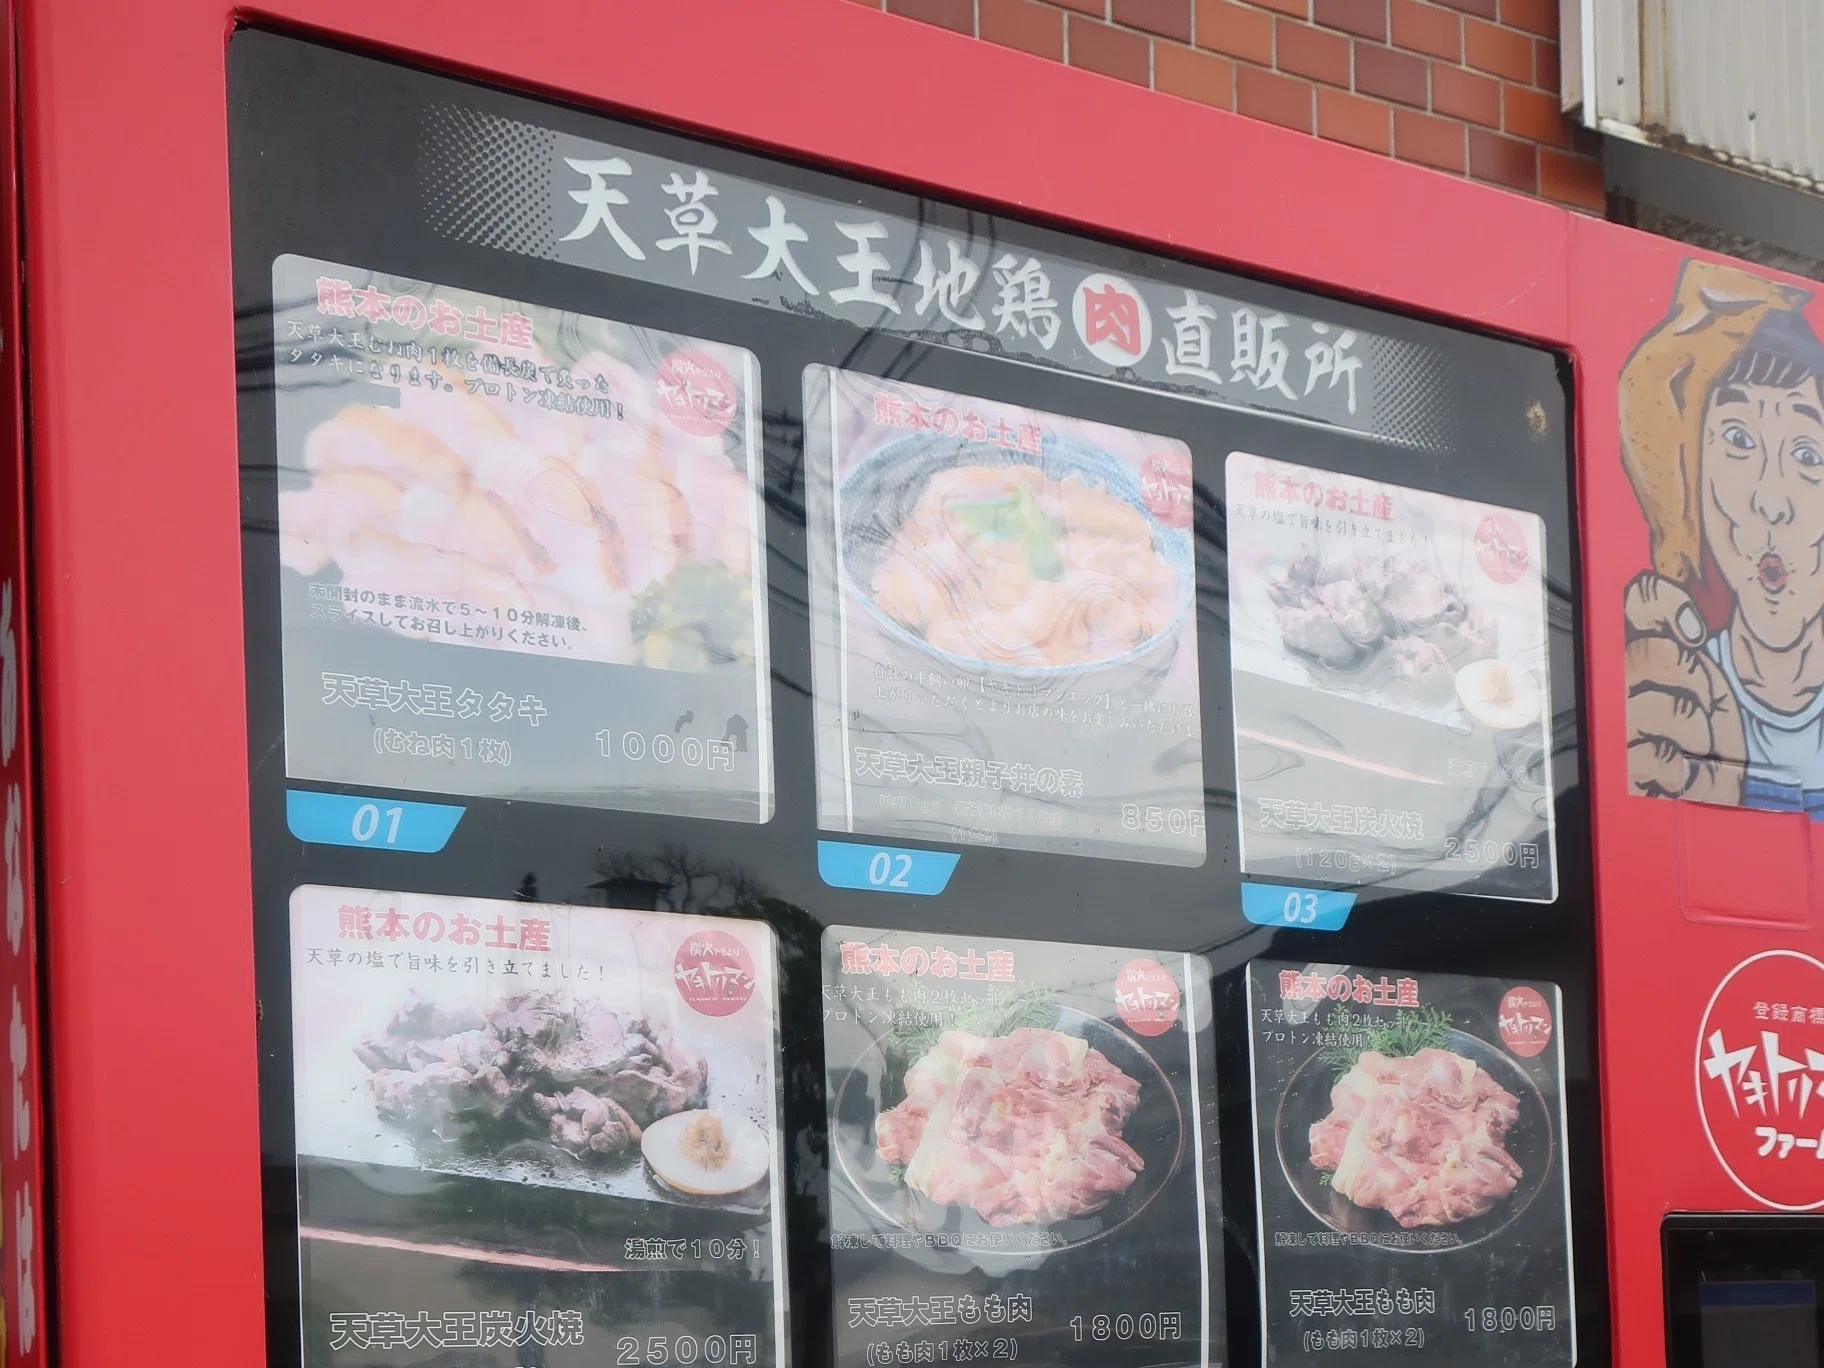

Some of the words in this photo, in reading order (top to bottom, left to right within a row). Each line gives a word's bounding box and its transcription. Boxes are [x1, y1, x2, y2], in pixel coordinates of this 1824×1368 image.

[558, 156, 1364, 415] 天草大王地鶏肉直販所
[316, 275, 534, 351] 熊本のお土産
[873, 392, 1043, 457] 熊本のお土産
[1253, 470, 1394, 521] 熊本のお土産
[309, 603, 576, 651] スライスしてお召し上がりください。
[320, 671, 548, 727] 天草大王タタキ
[373, 728, 512, 766] (むね肉1枚)
[595, 729, 736, 772] 1000円
[854, 745, 1085, 799] 天草大王親子丼の素
[351, 803, 405, 844] 01
[1257, 797, 1425, 841] 天草大王炭火焼
[868, 851, 914, 889] 02
[1443, 836, 1540, 869] 2500円
[1283, 891, 1319, 924] 03
[337, 903, 552, 953] 熊本のお土産
[304, 946, 606, 983] 天草の塩で旨味を引き立てました！
[674, 961, 756, 993] ヤキトリマン
[839, 940, 1016, 982] 熊本のお土産
[1278, 968, 1420, 1009] 熊本のお土産
[623, 1237, 761, 1262] 湯煎で10分！
[847, 1292, 1034, 1329] 天草大王もも肉
[1289, 1287, 1437, 1318] 天草大王もも肉
[1464, 1304, 1557, 1332] 1800円
[328, 1309, 585, 1352] 天草大王炭火焼
[1069, 1311, 1183, 1343] 1800円
[1303, 1327, 1426, 1352] (もも肉1枚×2)
[615, 1333, 758, 1367] 2500円
[866, 1337, 1019, 1367] (もも肉1枚×2)
